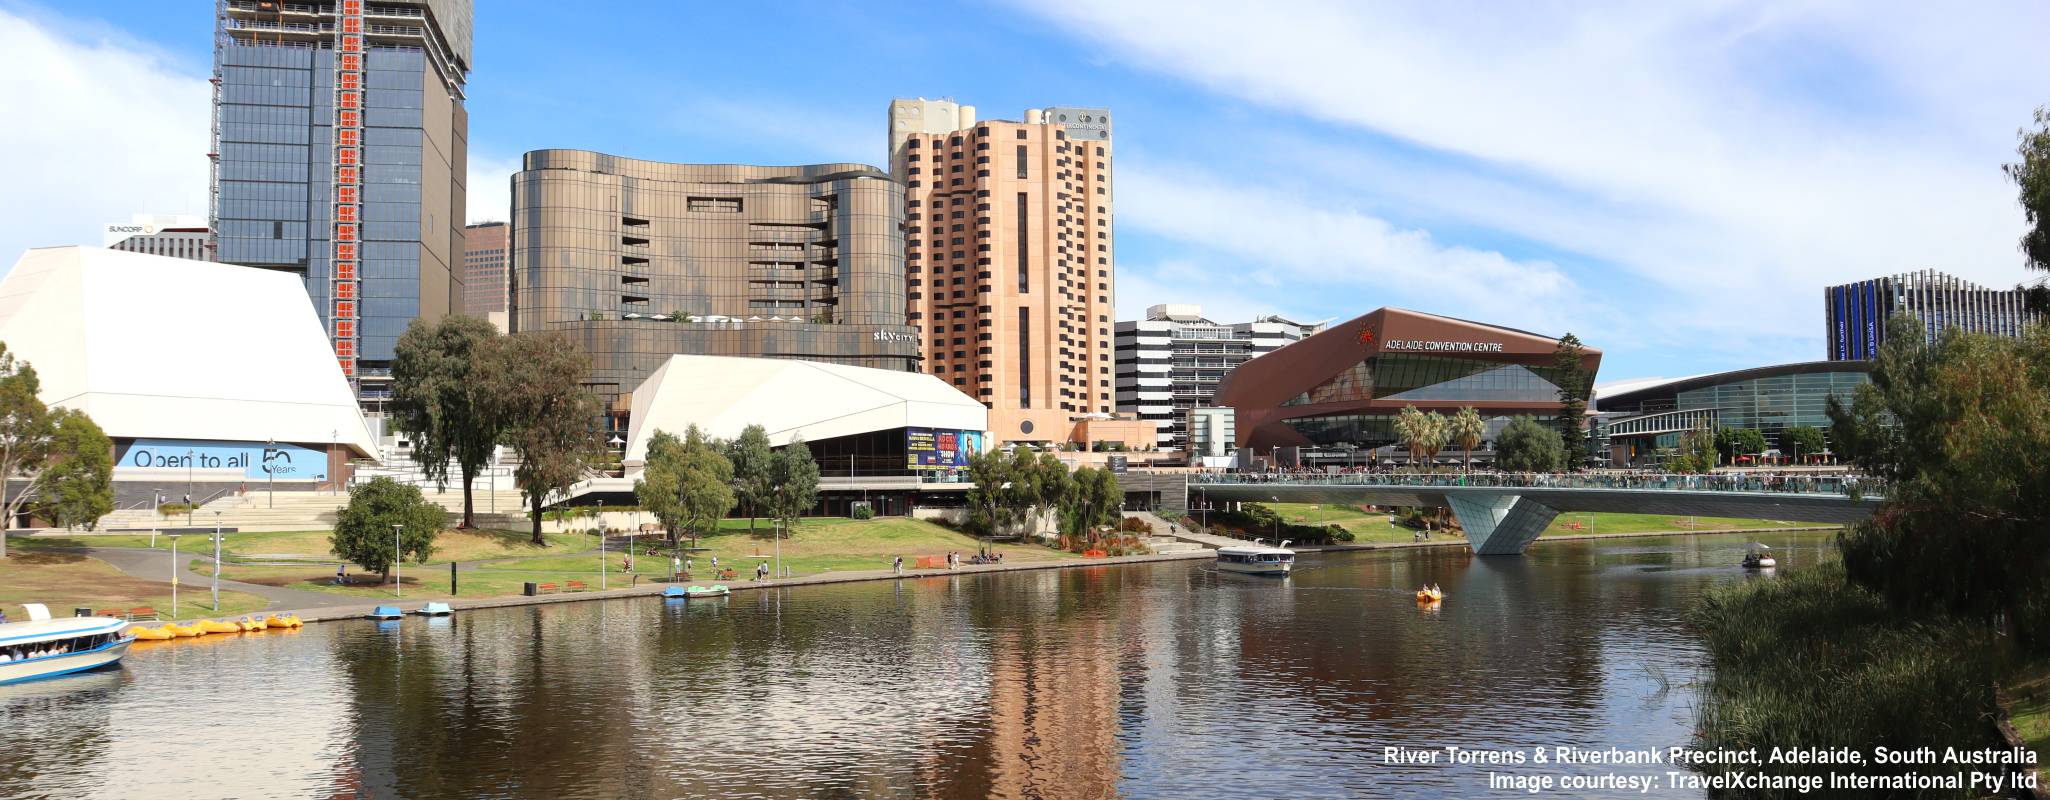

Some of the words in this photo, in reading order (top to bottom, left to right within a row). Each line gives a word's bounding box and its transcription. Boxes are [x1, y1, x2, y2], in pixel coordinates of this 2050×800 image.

[109, 225, 143, 233] SUNCORP
[1386, 340, 1424, 350] ADELAIDE
[1425, 341, 1472, 351] CONVENTION
[1473, 342, 1504, 352] CENTRE
[134, 450, 193, 468] Open
[200, 452, 221, 468] to
[227, 452, 249, 468] all
[271, 464, 297, 474] Years
